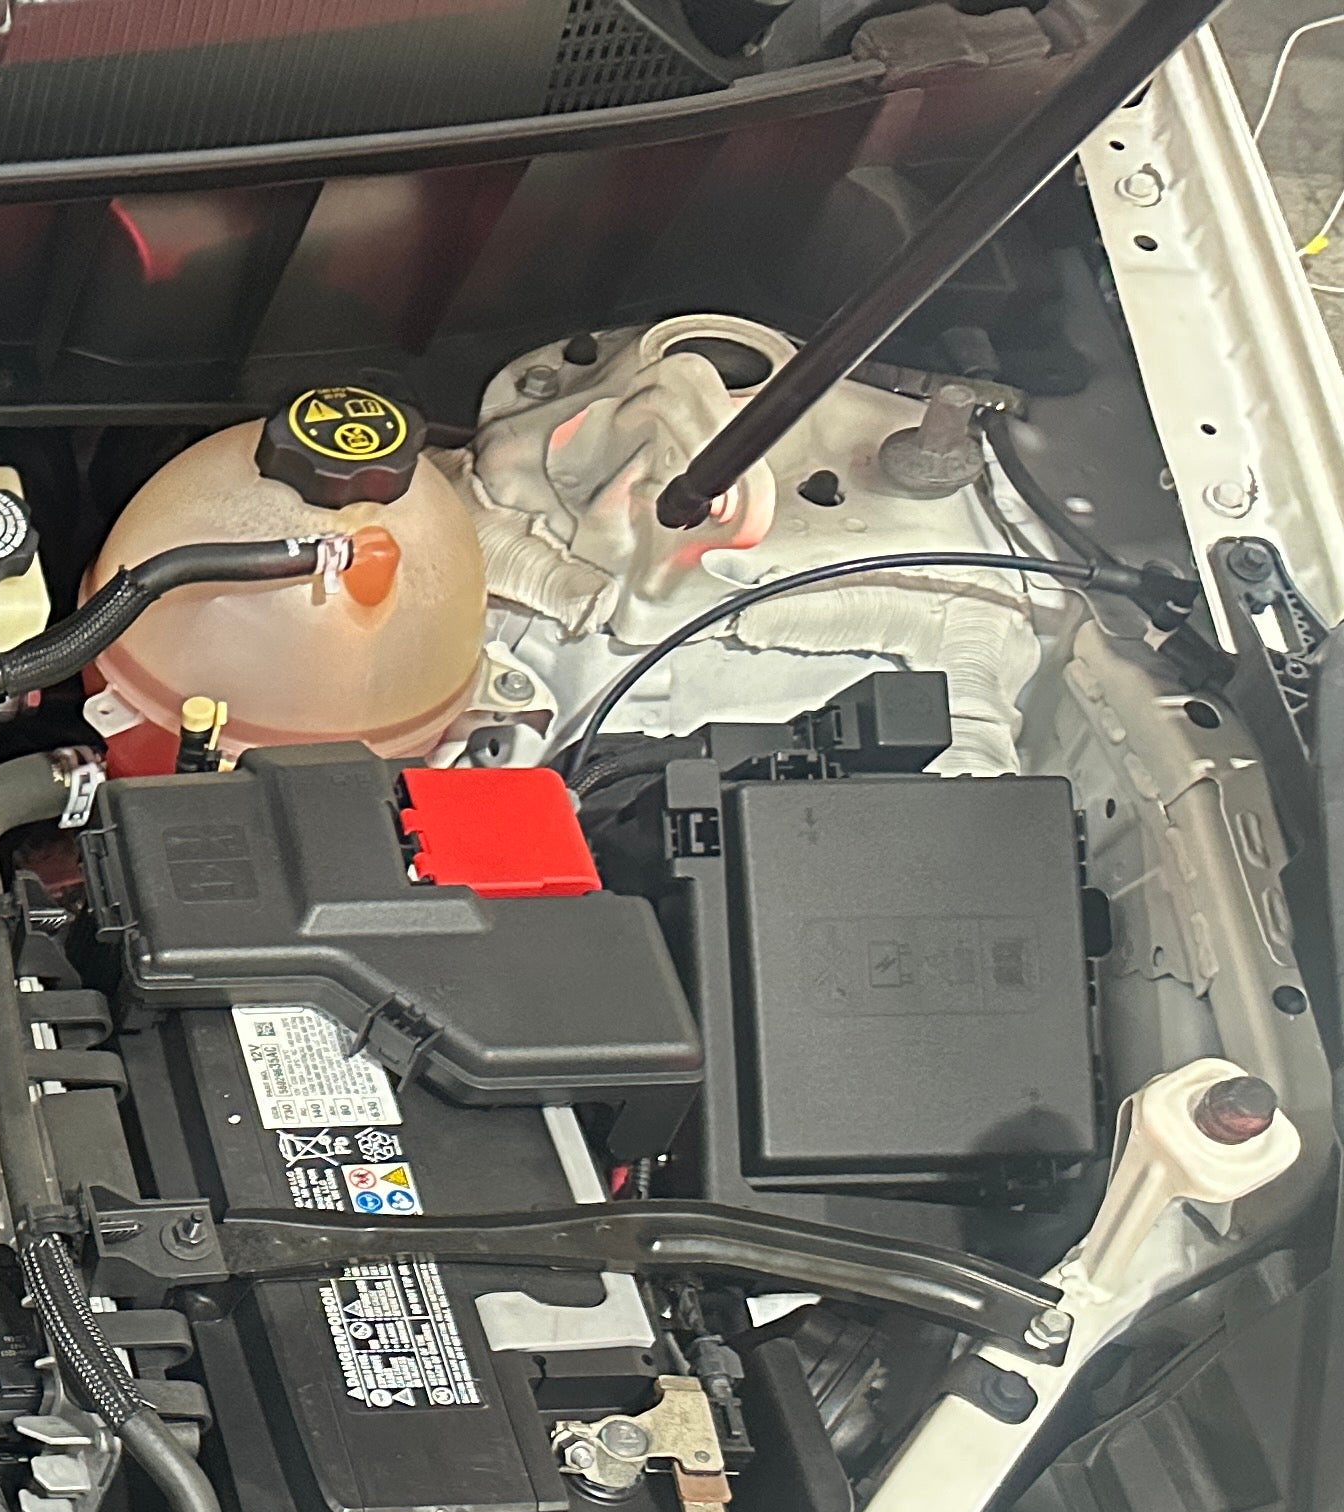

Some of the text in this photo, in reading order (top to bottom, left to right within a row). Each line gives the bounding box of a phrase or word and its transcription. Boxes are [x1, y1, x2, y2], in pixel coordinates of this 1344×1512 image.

[248, 1044, 264, 1062] 12V
[282, 1104, 295, 1120] 730
[310, 1103, 323, 1119] 140
[367, 1101, 381, 1118] 630
[332, 1135, 353, 1155] Pb
